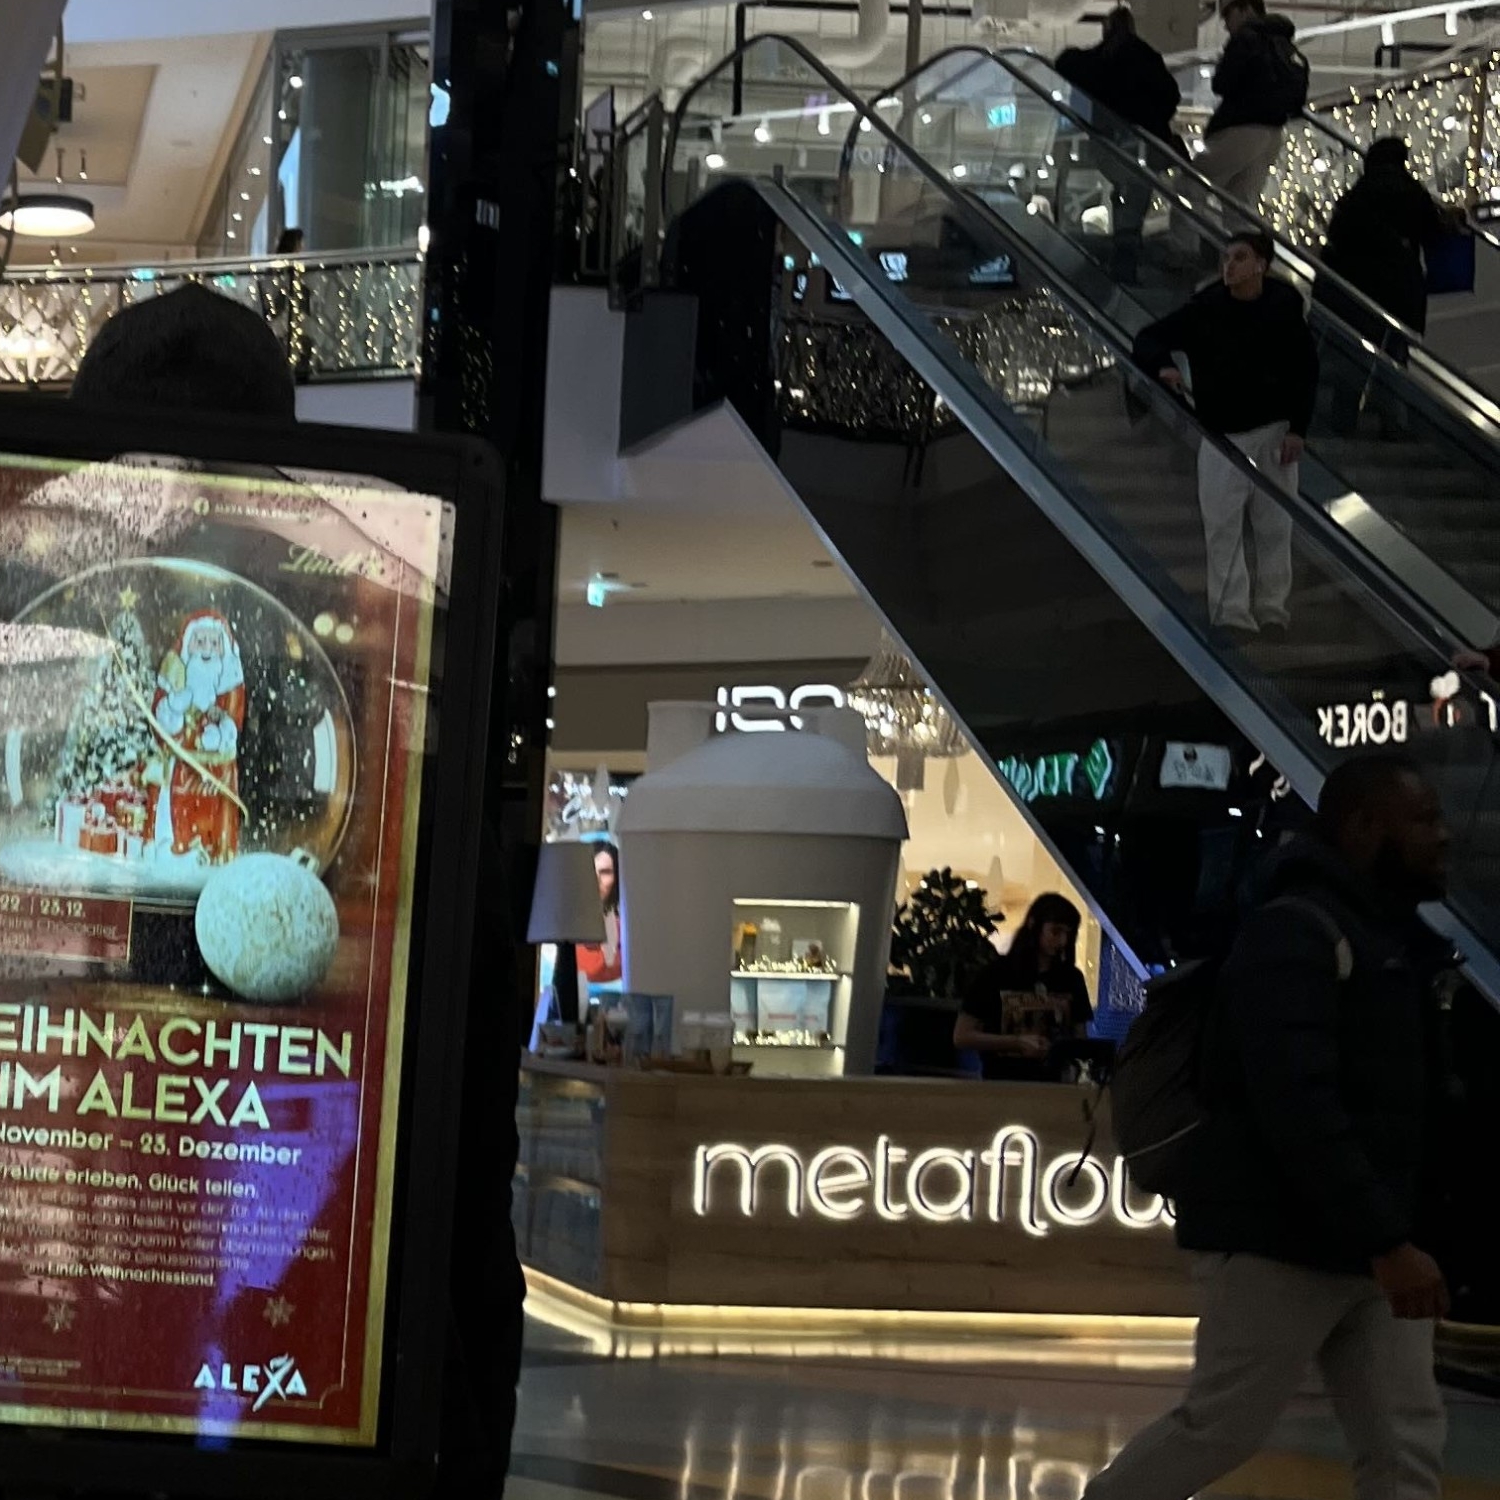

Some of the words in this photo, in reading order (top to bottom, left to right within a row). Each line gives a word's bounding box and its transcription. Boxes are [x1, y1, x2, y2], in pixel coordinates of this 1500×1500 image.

[76, 1067, 270, 1129] ALEXA
[178, 1136, 302, 1166] Dezember
[65, 1168, 143, 1191] erleben,
[148, 1173, 199, 1195] Glück
[193, 1352, 308, 1413] ALEXA
